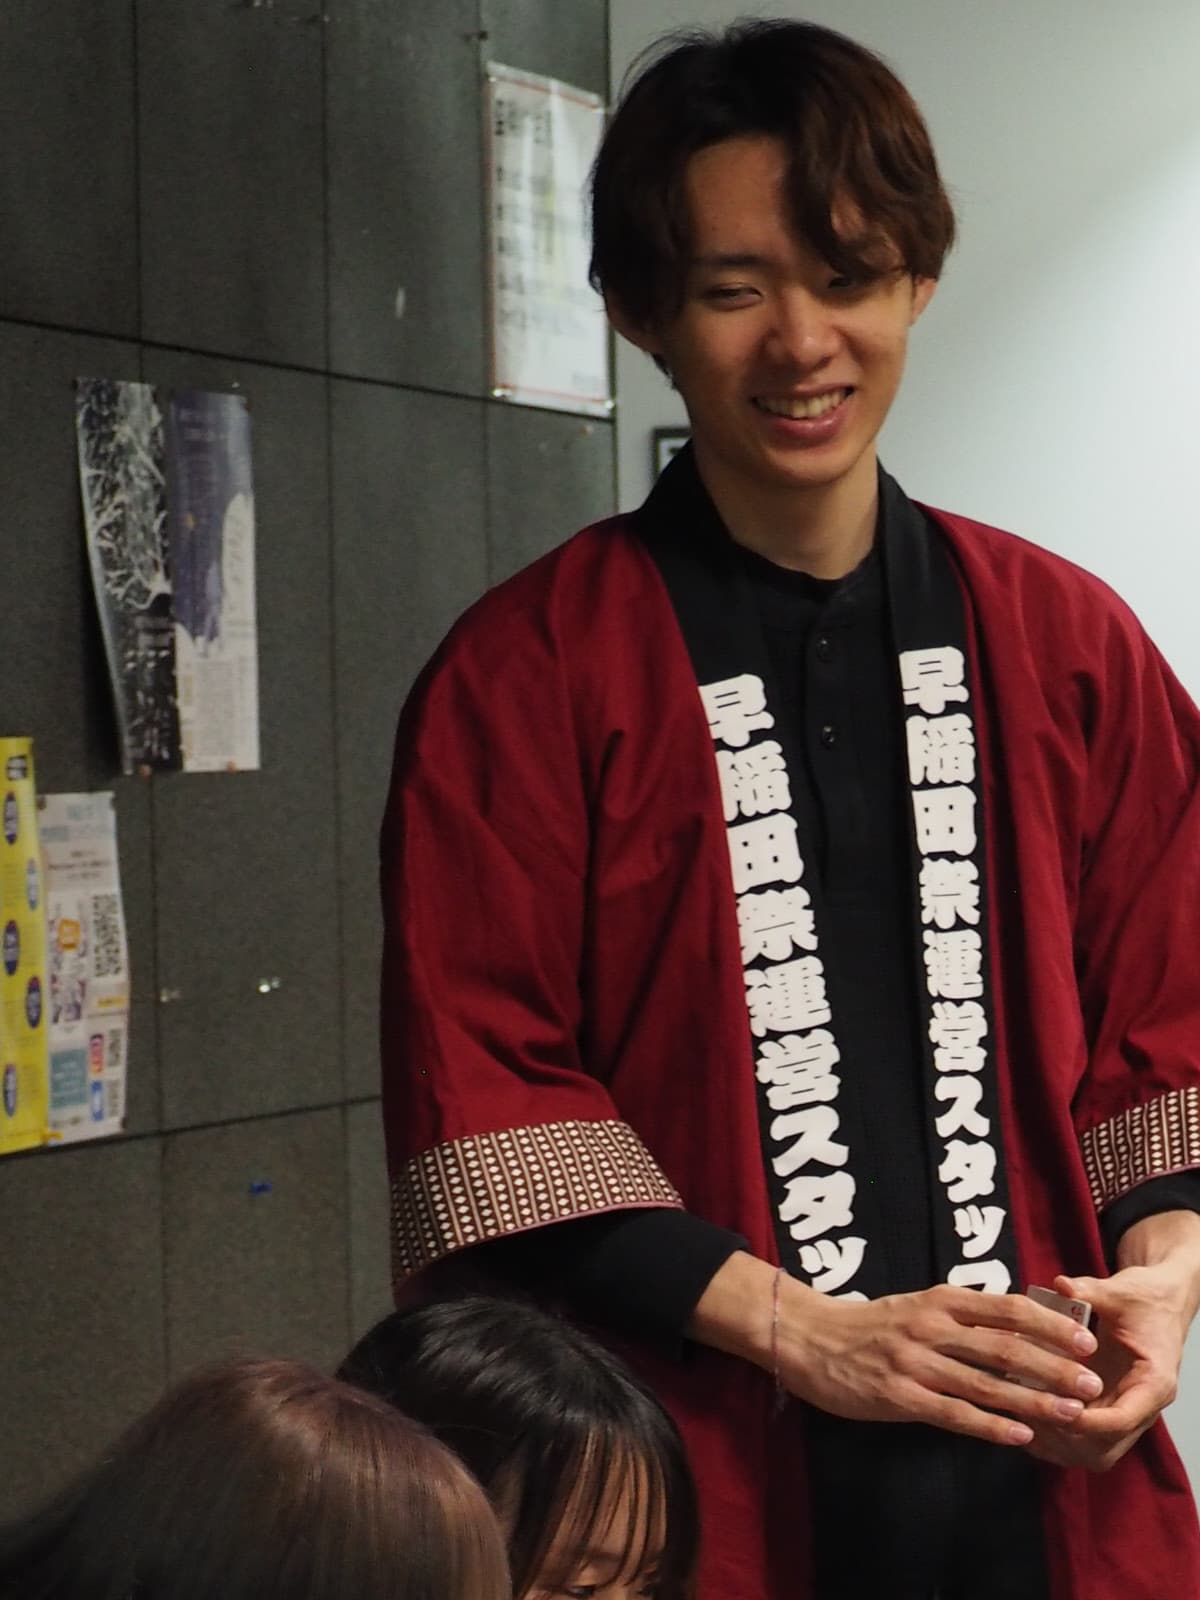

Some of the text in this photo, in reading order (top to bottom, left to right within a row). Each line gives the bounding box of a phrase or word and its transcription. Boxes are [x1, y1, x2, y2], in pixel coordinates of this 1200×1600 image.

[698, 673, 870, 1302] 早稲田祭運営スタッ
